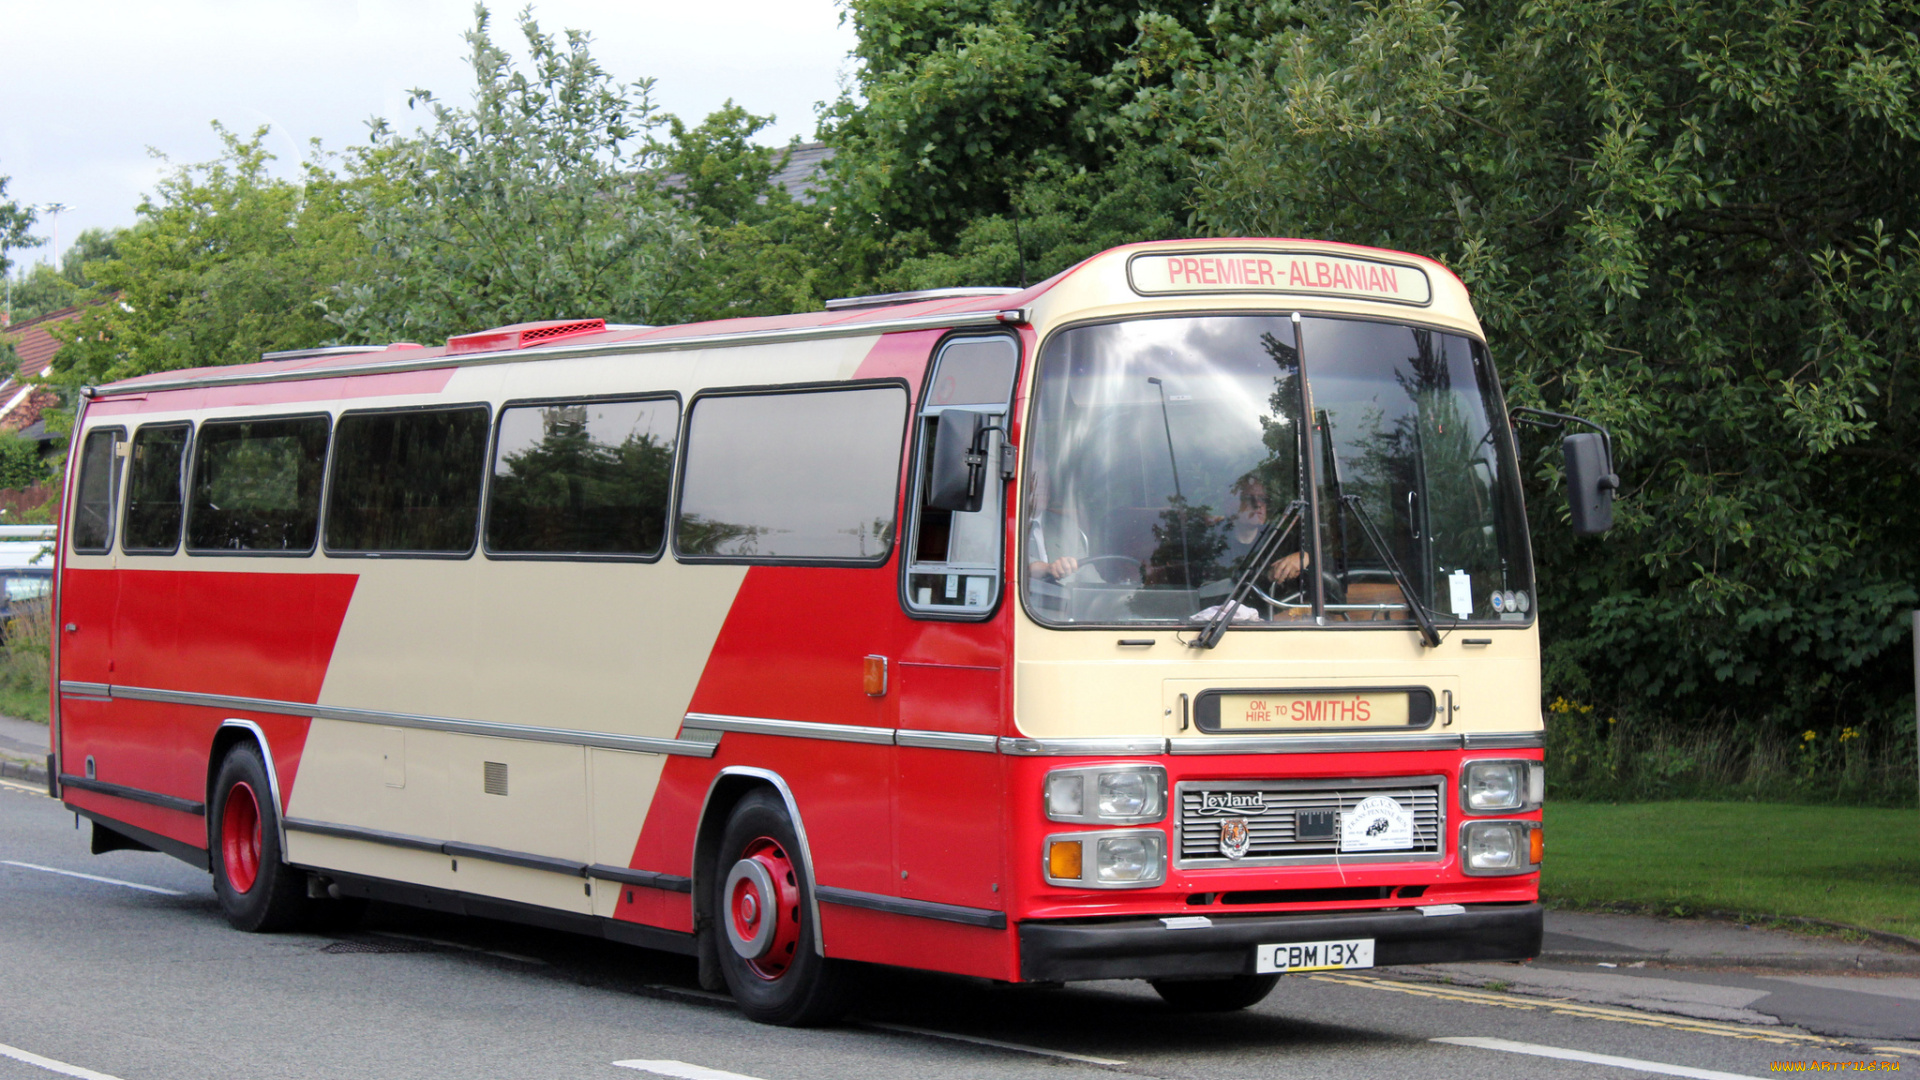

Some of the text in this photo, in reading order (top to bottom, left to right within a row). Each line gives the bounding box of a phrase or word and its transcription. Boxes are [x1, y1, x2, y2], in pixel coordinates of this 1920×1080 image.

[1167, 257, 1399, 293] PREMIER-ALBANIAN
[1246, 711, 1271, 722] HIRE
[1250, 700, 1267, 711] ON
[1275, 695, 1371, 722] TO SMITH'S
[1198, 791, 1268, 815] Leyland
[1273, 943, 1359, 968] CBM 13X
